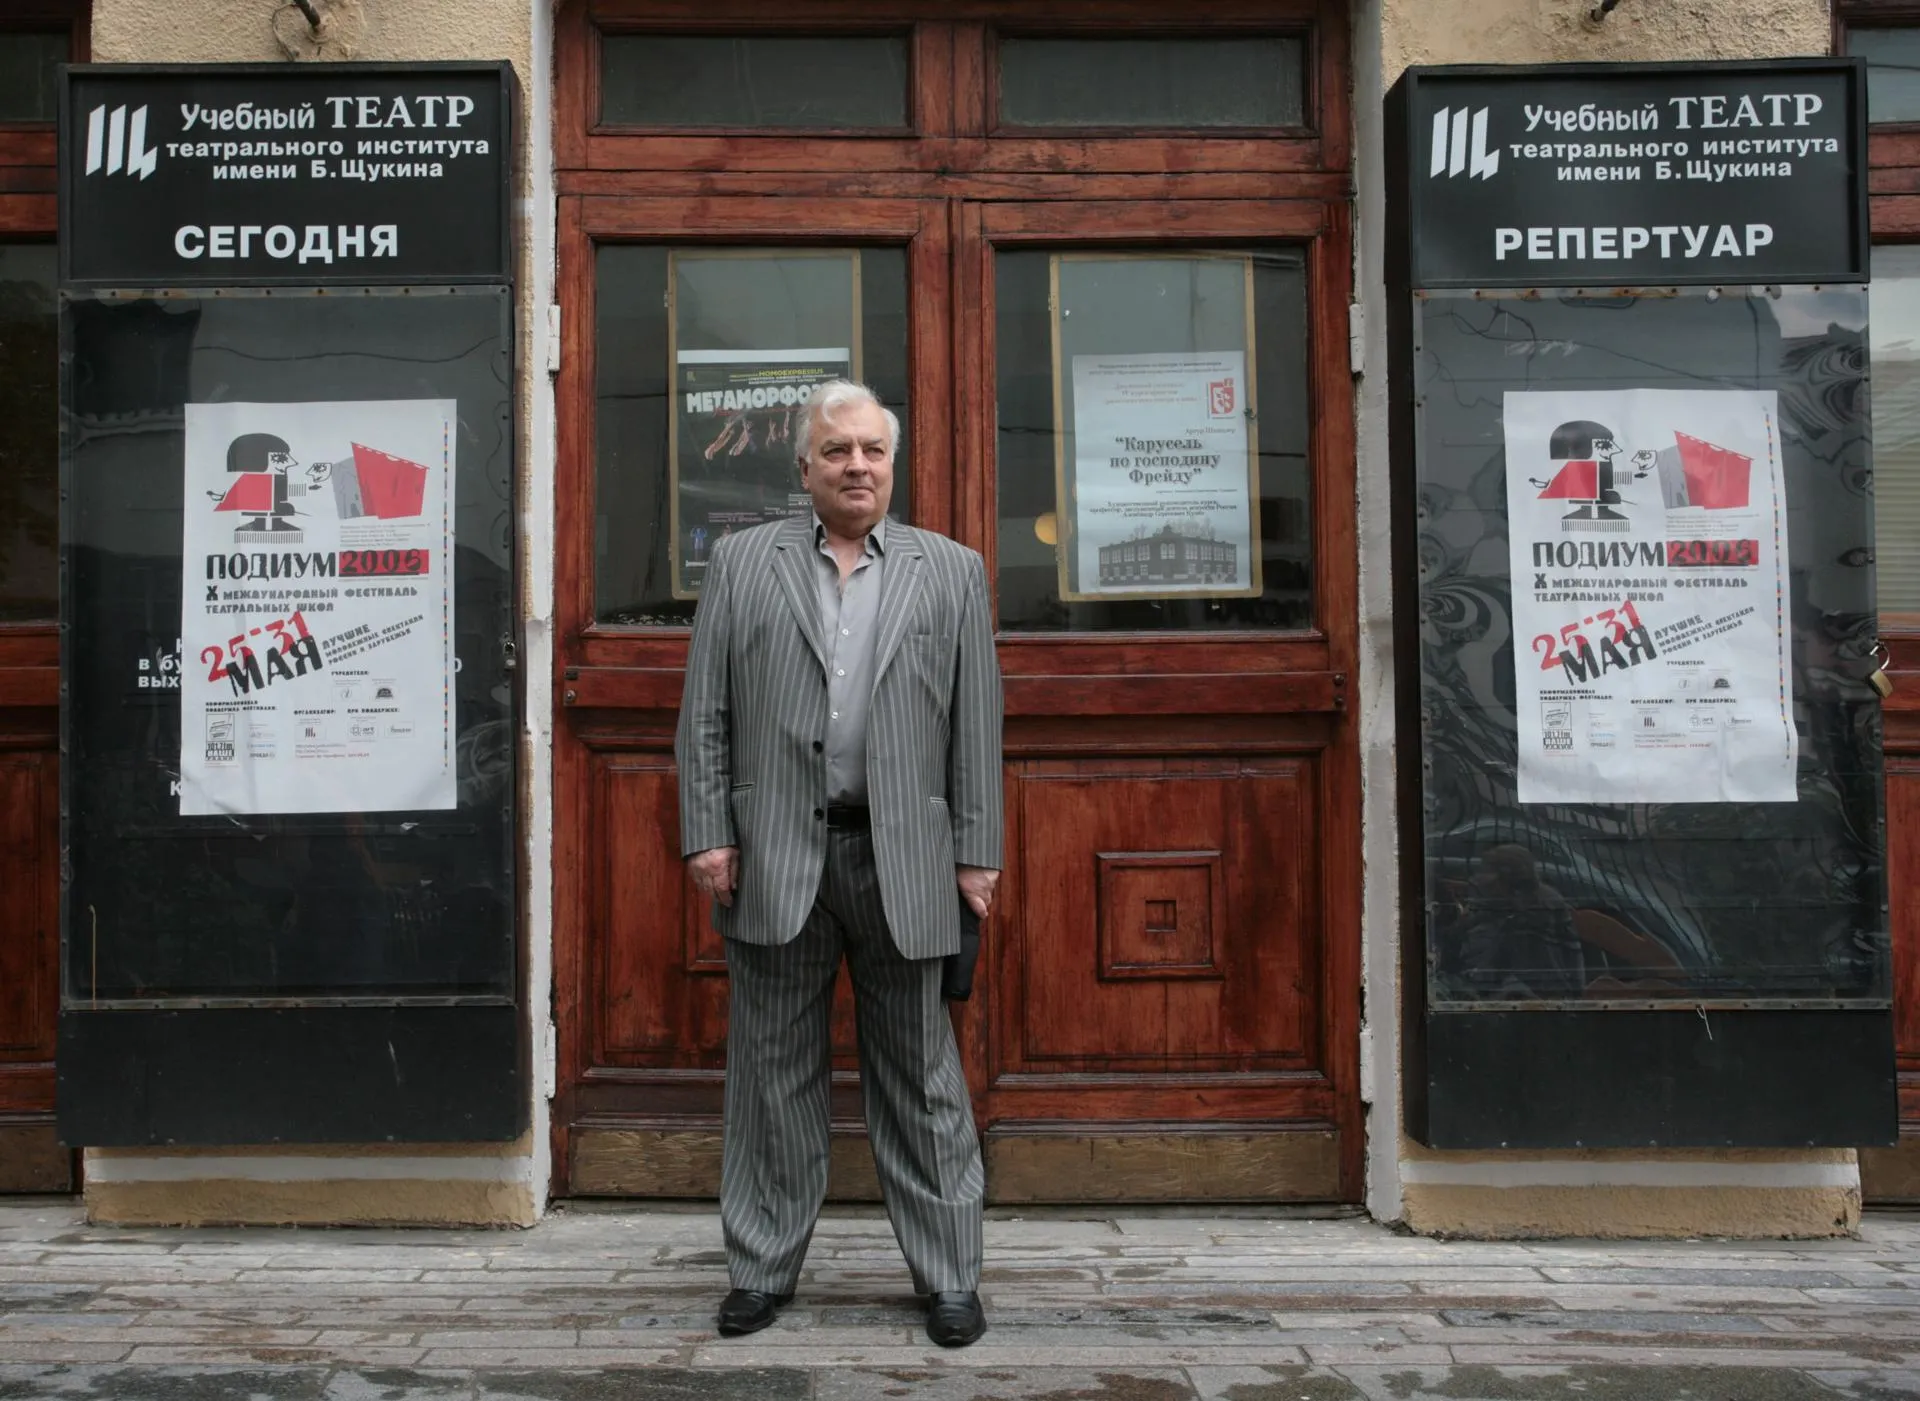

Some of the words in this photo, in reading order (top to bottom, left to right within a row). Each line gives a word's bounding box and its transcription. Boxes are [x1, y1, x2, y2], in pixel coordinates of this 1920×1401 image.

[181, 102, 315, 131] Учебный
[325, 95, 474, 129] ТЕАТР
[1524, 104, 1659, 132] Учебный
[1668, 94, 1823, 130] ТЕАТР
[166, 139, 344, 160] театрального
[357, 137, 489, 158] института
[1510, 142, 1689, 163] театрального
[1703, 136, 1839, 157] института
[213, 164, 297, 180] имени
[311, 159, 443, 183] Б.Щукина
[1557, 165, 1641, 181] имени
[1656, 160, 1792, 183] Б.Щукина
[174, 224, 398, 264] СЕГОДНЯ
[1496, 223, 1773, 260] РЕПЕРТУАР
[1110, 455, 1129, 468] по
[1134, 453, 1220, 469] господину
[206, 552, 336, 581] ПОДИУМ
[1533, 541, 1665, 570] ПОДИУМ
[223, 587, 338, 600] МЕЖДУНАРОДНЫЙ
[344, 586, 418, 598] ФЕСТИВАЛЬ
[1552, 577, 1668, 589] МЕЖДУНАРОДНЫЙ
[1674, 576, 1748, 588] ФЕСТИВАЛЬ
[206, 603, 290, 614] ТЕАТРАЛЬНЫХ
[296, 602, 334, 613] ШКОЛ
[1534, 592, 1620, 602] ТЕАТРАЛЬНЫХ
[1627, 592, 1664, 602] ШКОЛ
[322, 624, 370, 650] ЛУЧШИЕ
[1532, 599, 1642, 671] 25-31
[1654, 614, 1703, 640] ЛУЧШИЕ
[201, 610, 310, 682] 25-31
[1558, 624, 1657, 686] МАЯ
[226, 635, 323, 697] МАЯ
